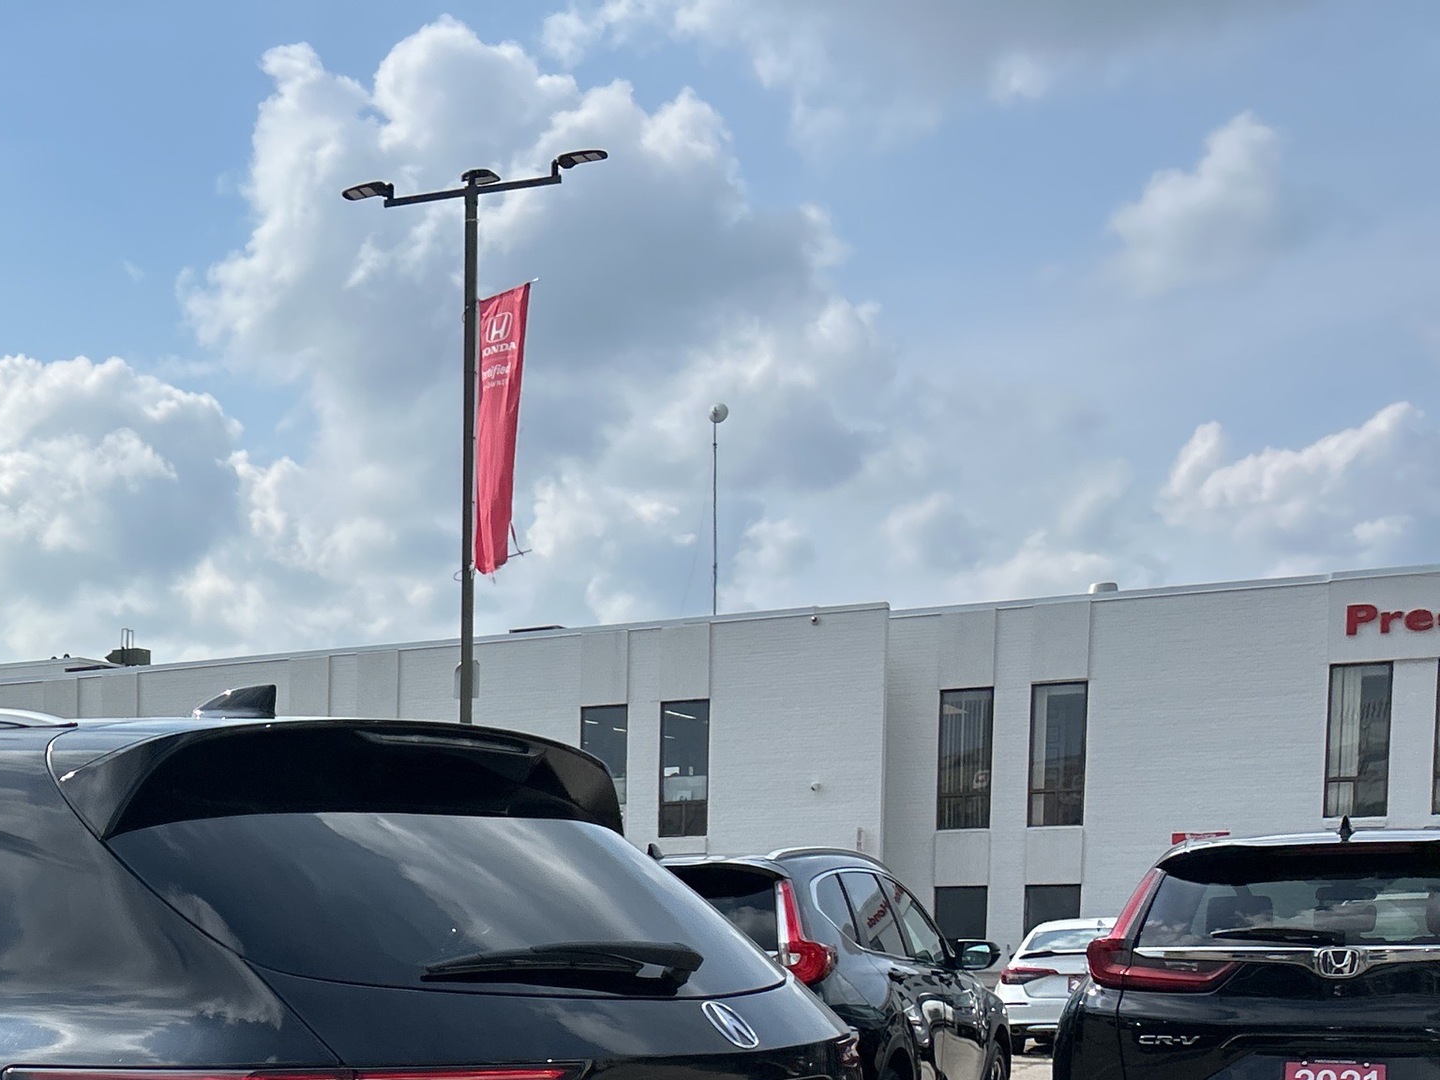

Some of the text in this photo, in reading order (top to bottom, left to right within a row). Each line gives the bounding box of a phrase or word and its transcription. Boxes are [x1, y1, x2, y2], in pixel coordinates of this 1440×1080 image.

[482, 341, 516, 357] ONDA
[1346, 603, 1440, 636] Pre
[1139, 1035, 1200, 1045] CR-V
